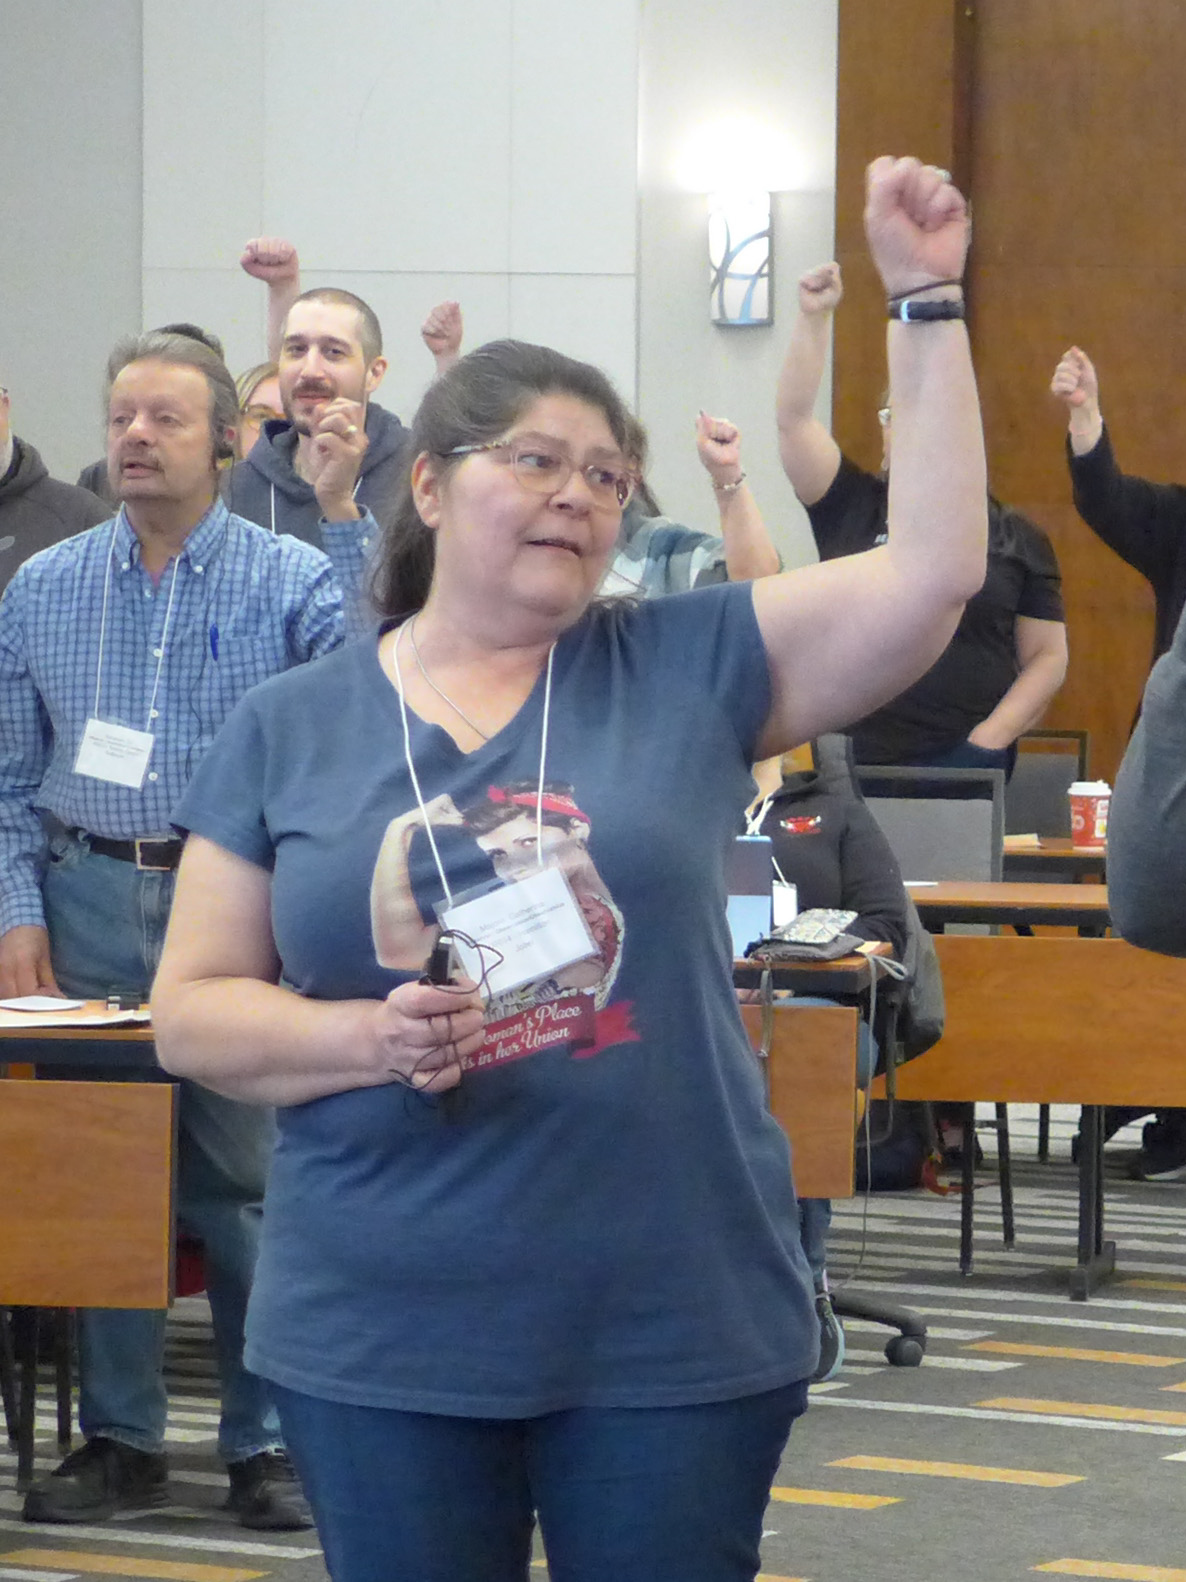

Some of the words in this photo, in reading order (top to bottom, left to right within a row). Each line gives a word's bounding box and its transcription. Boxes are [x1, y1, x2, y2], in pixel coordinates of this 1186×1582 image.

[481, 1013, 534, 1045] oman's
[535, 1002, 582, 1028] Place
[477, 1052, 493, 1066] in
[520, 1027, 570, 1048] Union
